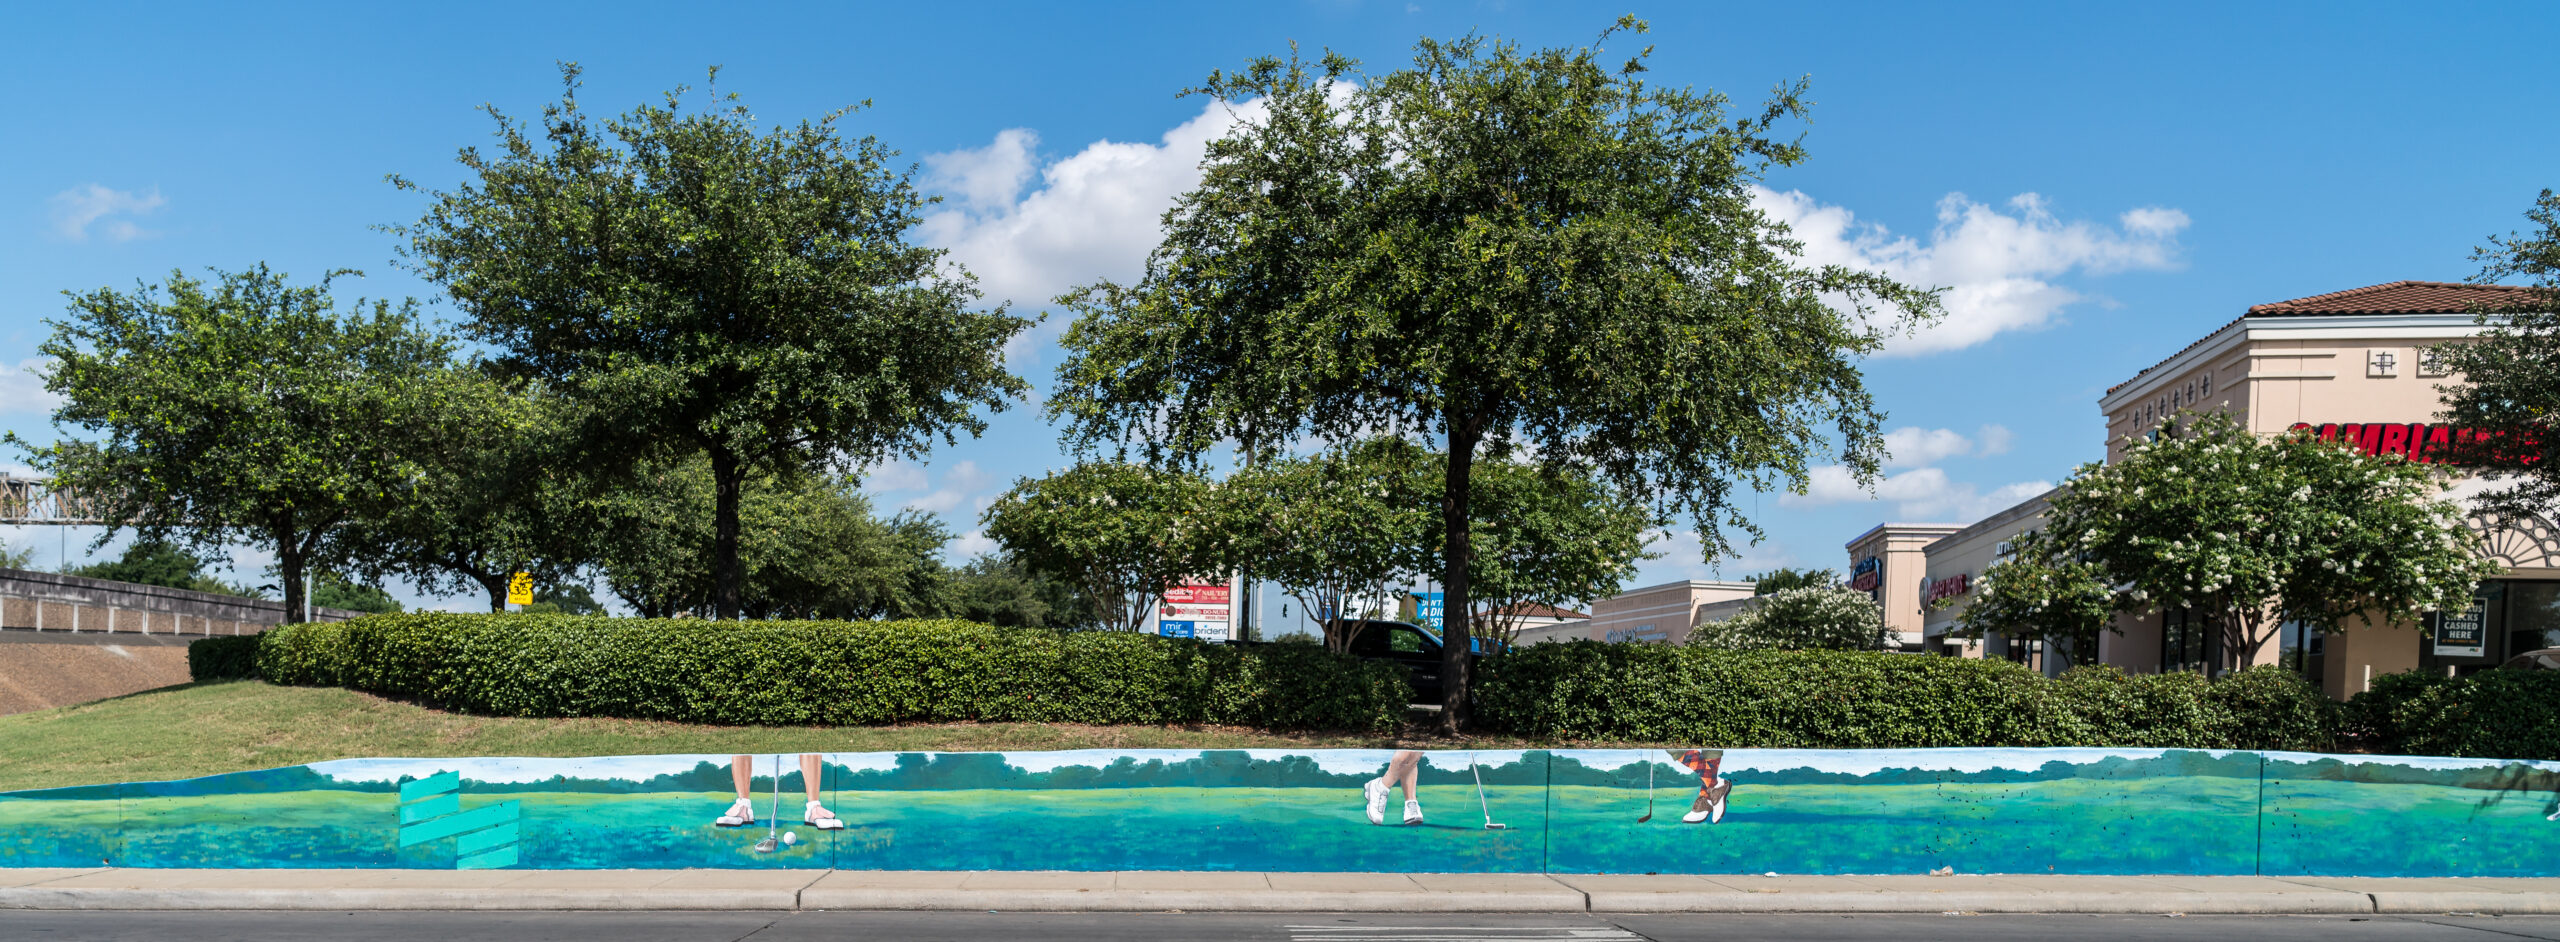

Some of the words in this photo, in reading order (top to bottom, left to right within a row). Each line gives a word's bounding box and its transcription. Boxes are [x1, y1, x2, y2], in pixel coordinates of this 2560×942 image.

[511, 586, 528, 595] 35
[1194, 625, 1228, 635] brident
[2443, 621, 2478, 630] CASHED
[2449, 630, 2472, 638] HERE
